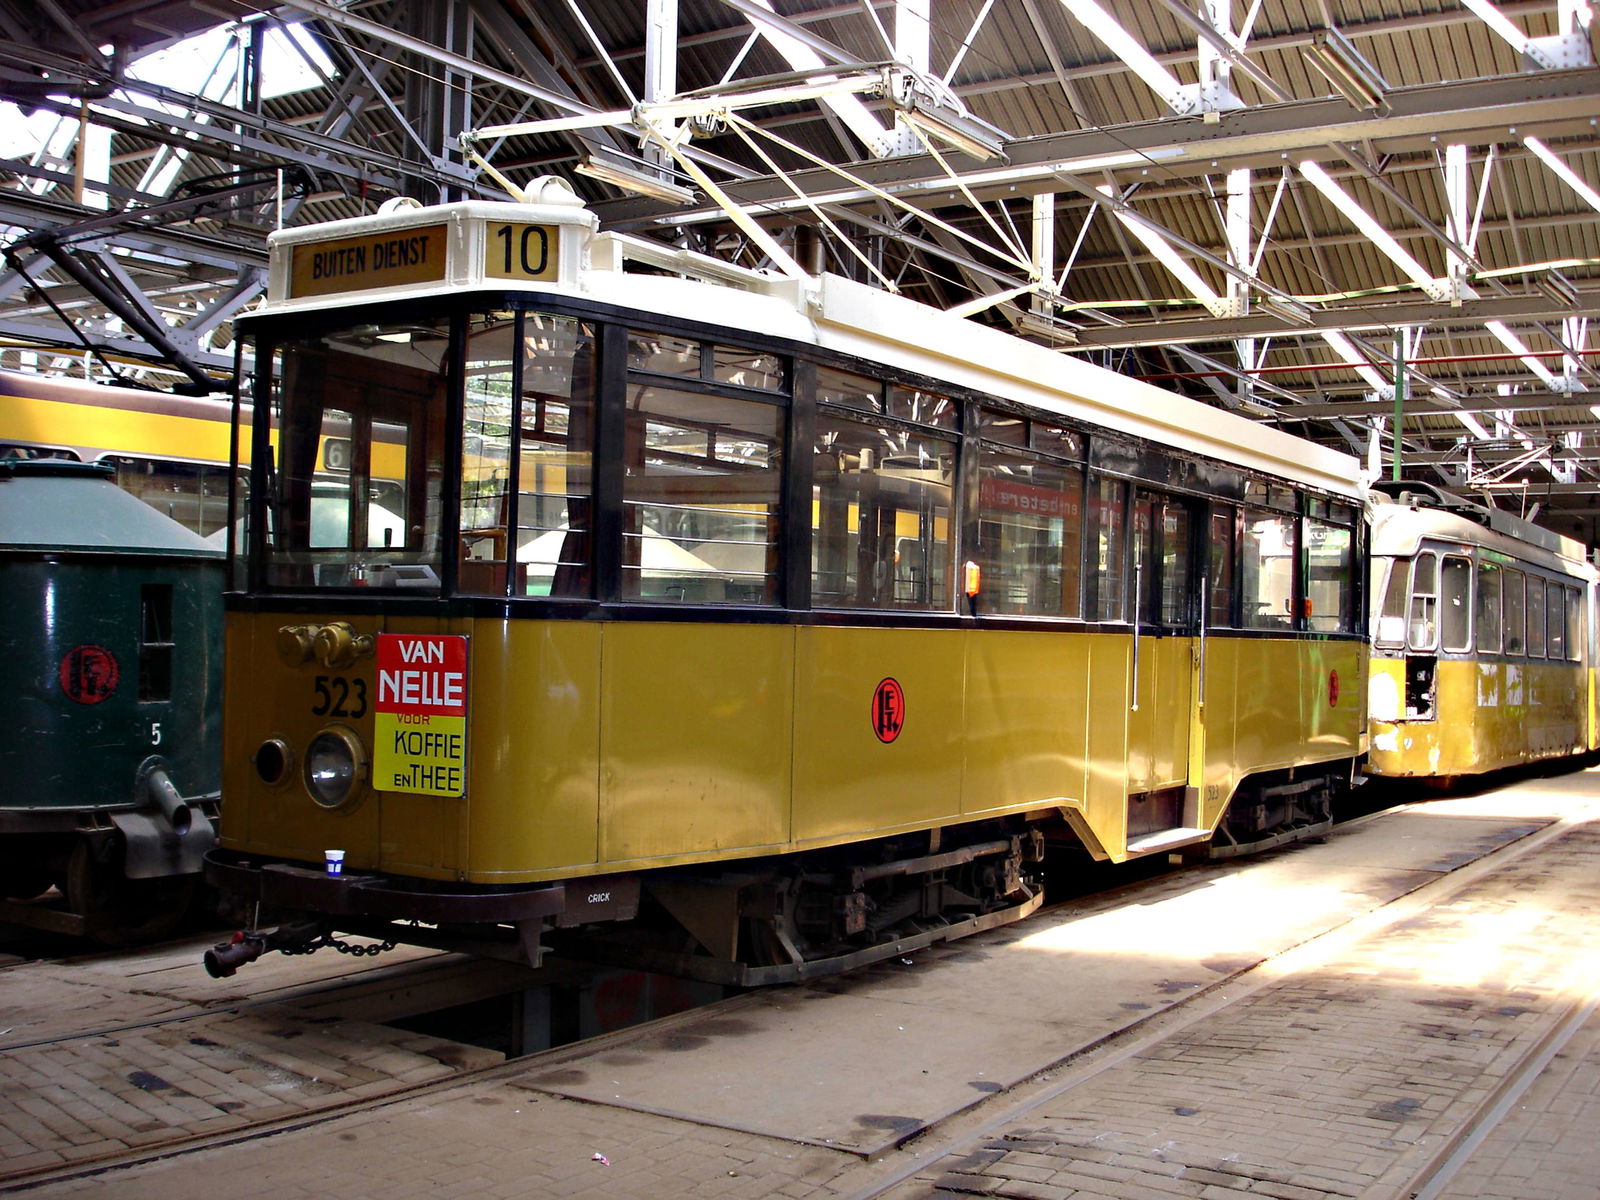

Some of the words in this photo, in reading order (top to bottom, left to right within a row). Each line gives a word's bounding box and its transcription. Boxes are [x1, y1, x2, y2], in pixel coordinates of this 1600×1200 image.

[313, 245, 366, 280] BUITEN
[374, 236, 429, 271] DIENST
[498, 225, 548, 275] 10
[329, 443, 343, 467] 6
[398, 640, 444, 664] VAN
[311, 676, 368, 719] 523
[379, 669, 463, 706] NELLE
[397, 713, 430, 726] VOOR
[151, 722, 161, 746] 5
[394, 730, 461, 760] KOFFIE
[394, 773, 410, 787] EN
[410, 764, 460, 792] THEE
[587, 892, 611, 904] CRICK
